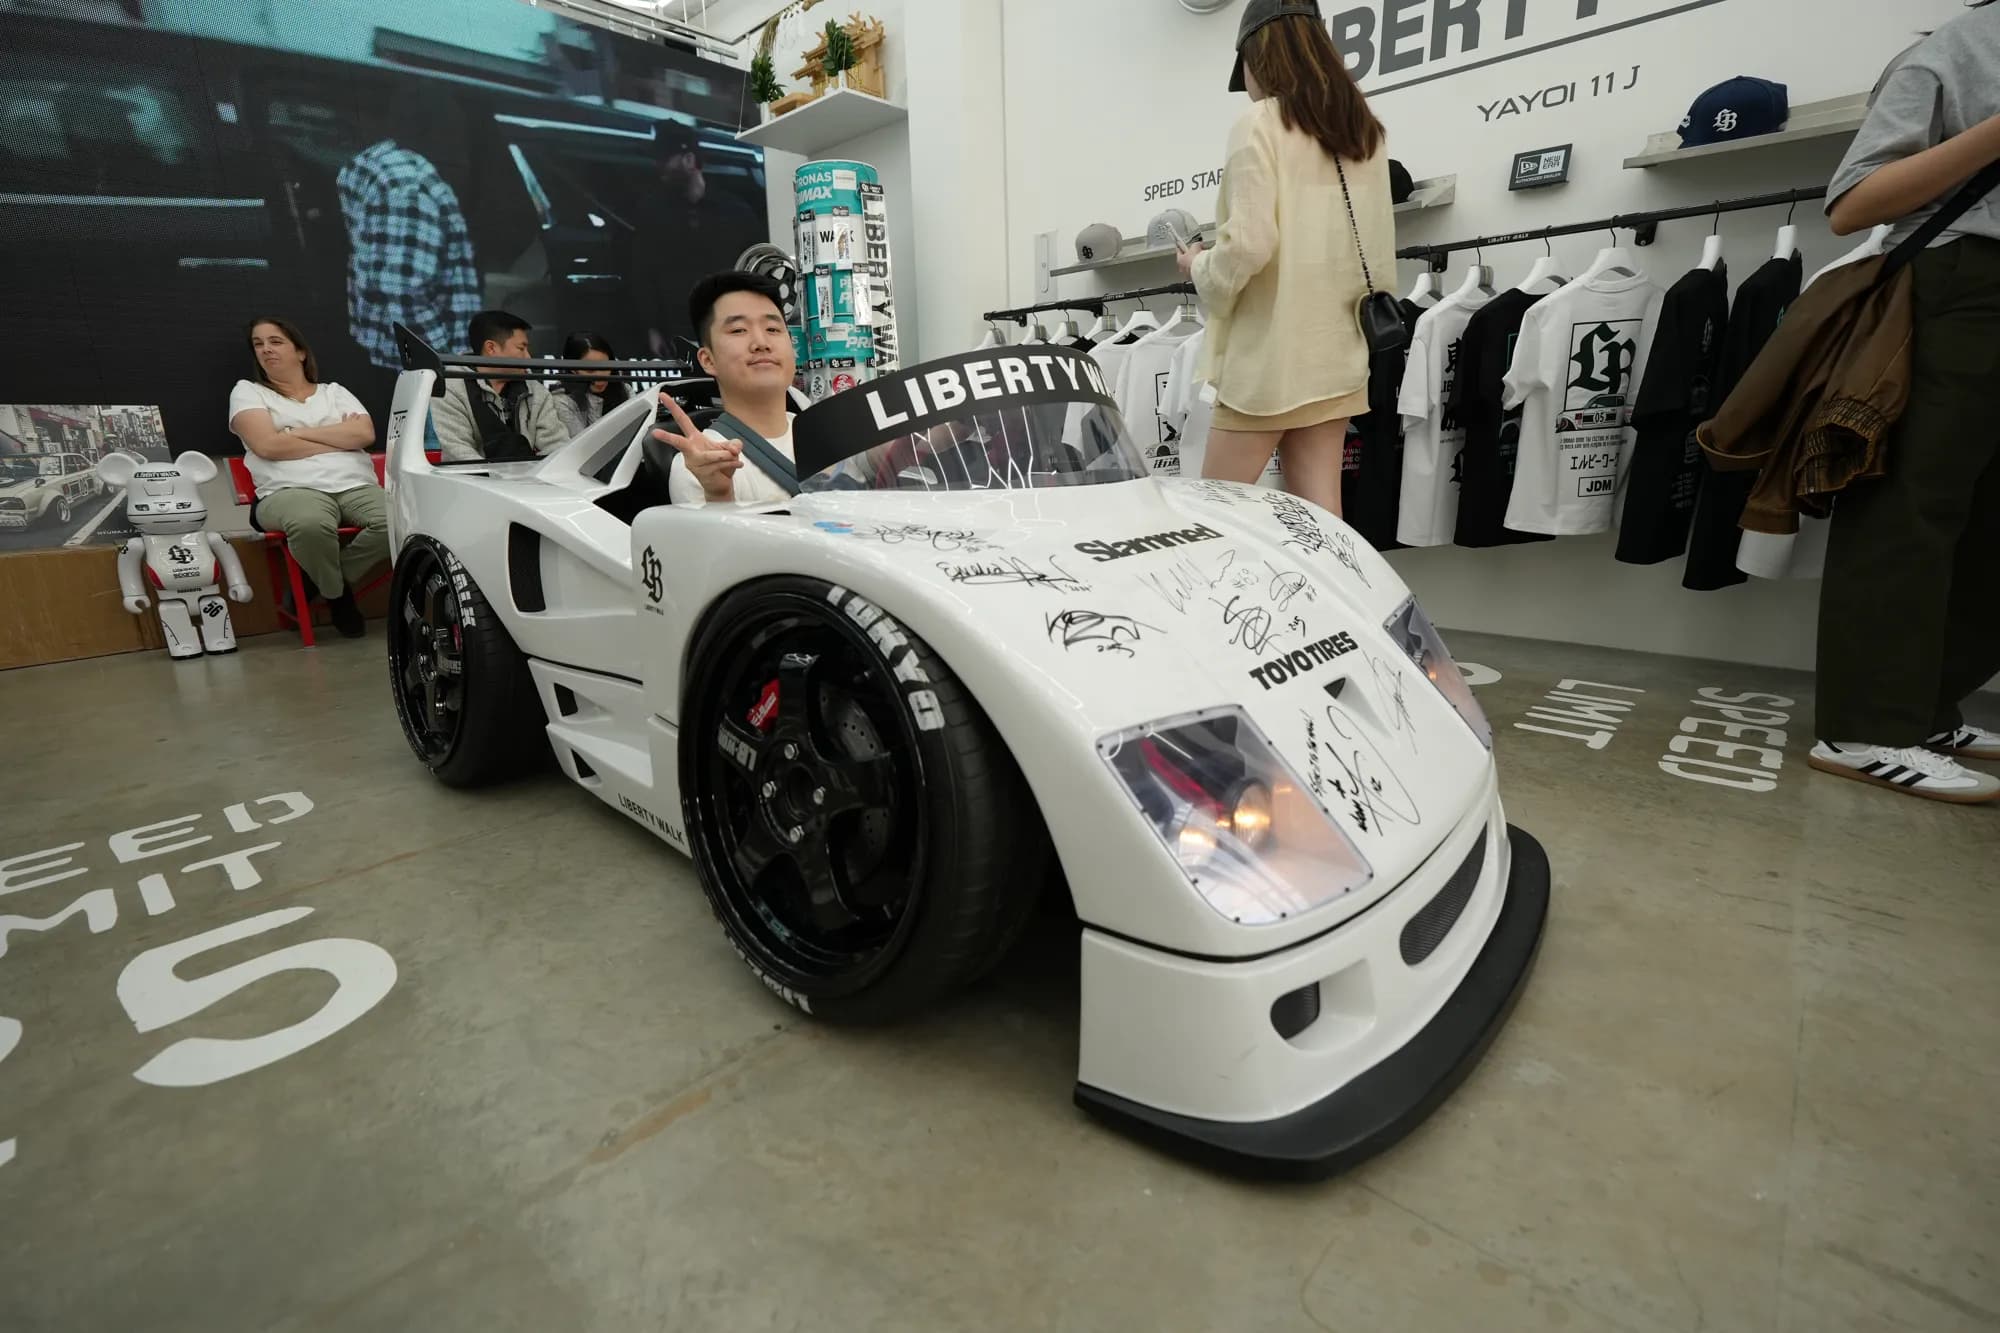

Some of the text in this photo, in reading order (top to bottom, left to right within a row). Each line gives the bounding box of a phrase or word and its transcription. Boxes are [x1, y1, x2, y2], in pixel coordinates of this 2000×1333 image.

[1478, 82, 1576, 121] YAYOI
[1144, 178, 1184, 202] SPEED
[1586, 479, 1612, 493] JDM
[1074, 523, 1225, 562] Slammed
[203, 601, 224, 618] 56
[1513, 678, 1646, 750] LIMIT
[1658, 686, 1795, 792] SPEED
[0, 791, 314, 896] EED
[0, 841, 282, 958] MIT
